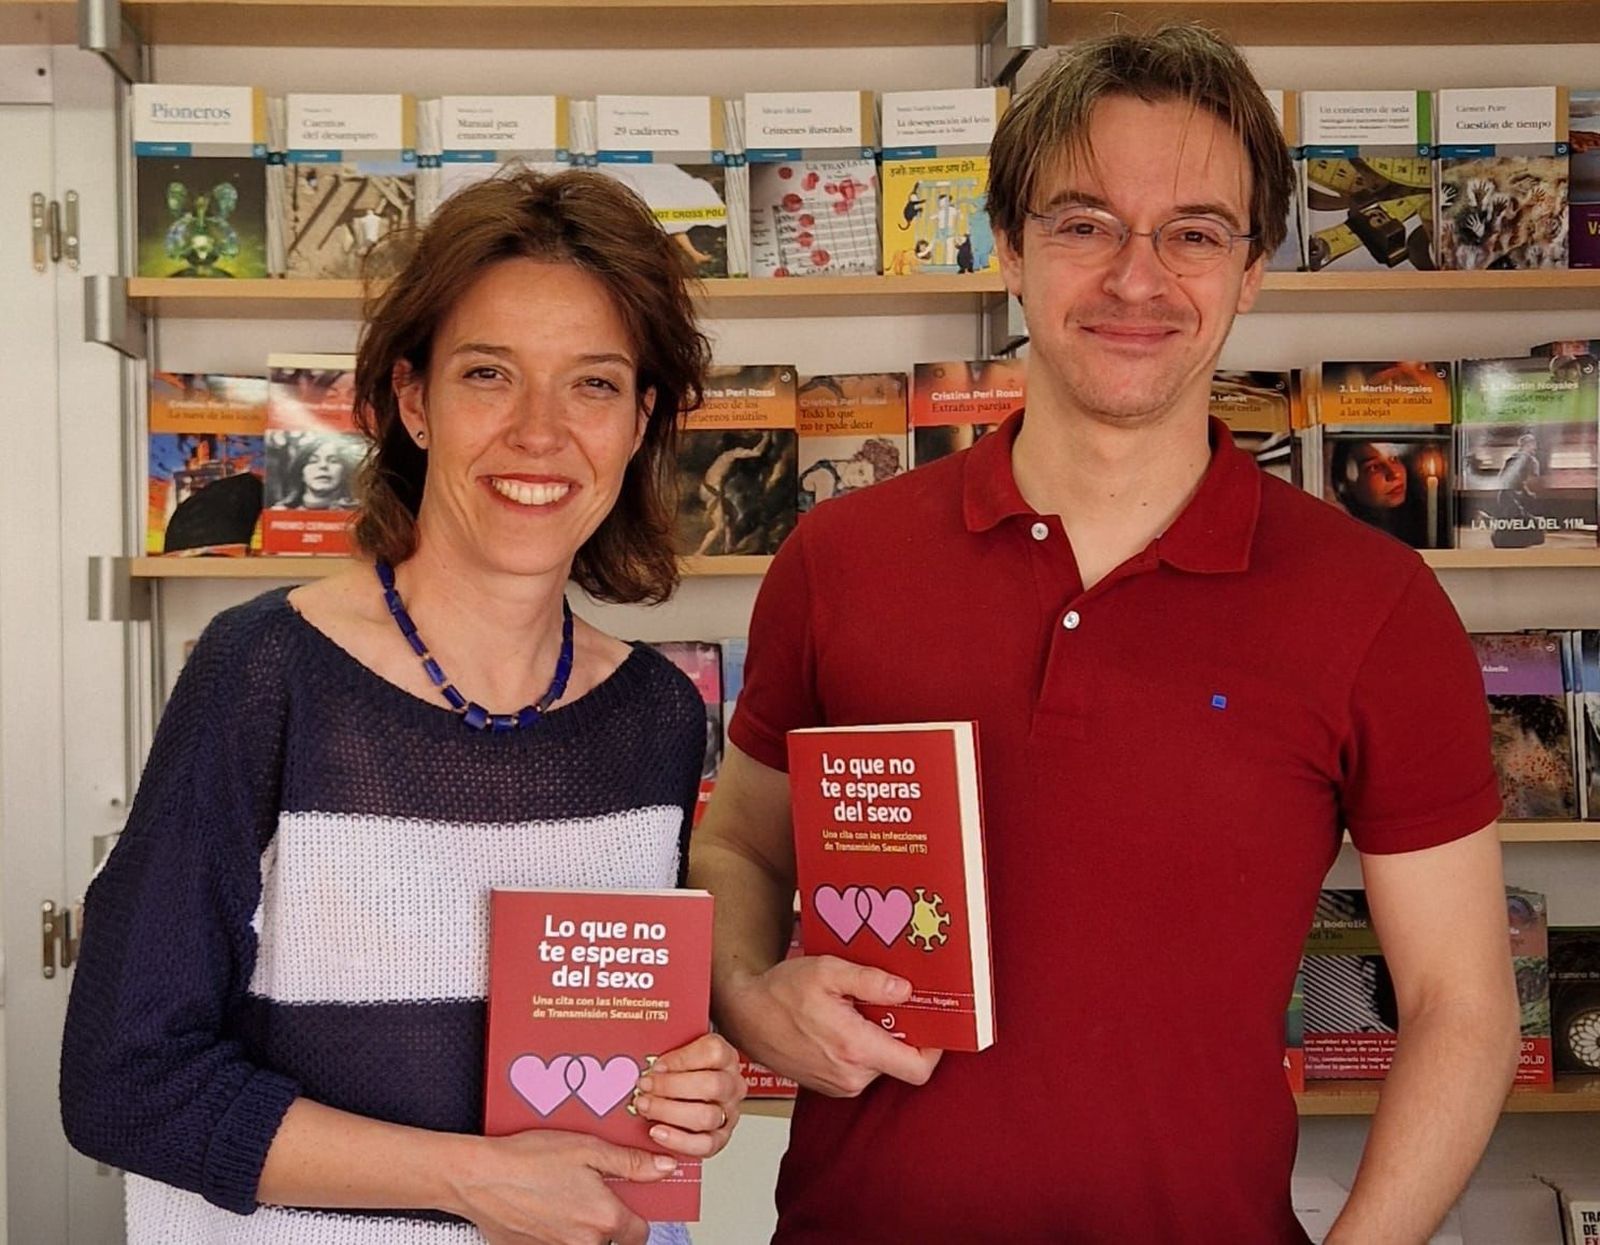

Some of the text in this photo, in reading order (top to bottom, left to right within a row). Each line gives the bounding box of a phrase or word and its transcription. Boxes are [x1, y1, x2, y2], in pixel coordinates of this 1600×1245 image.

[152, 102, 231, 119] Pioneros
[458, 119, 518, 130] Manual para
[808, 125, 853, 135] ilustrados
[1456, 119, 1552, 130] Cuestión de tiempo
[613, 126, 627, 136] 29
[673, 209, 704, 219] CROSS
[725, 387, 776, 397] Peri Rossi
[1395, 384, 1433, 394] Nogales
[1537, 381, 1579, 391] Nogales
[931, 386, 1023, 401] Cristina Peri Rossi
[731, 399, 742, 410] de
[1341, 395, 1352, 405] La
[932, 401, 1012, 413] Extrañas parejas
[1340, 407, 1391, 418] a las abejas
[801, 407, 855, 424] Todo lo que
[800, 422, 813, 431] no
[815, 421, 824, 430] te
[850, 419, 874, 430] decir
[1471, 517, 1585, 531] LA NOVELA DEL 11M
[822, 753, 915, 779] Lo que no
[820, 778, 921, 803] te esperas
[833, 800, 912, 822] del sexo
[822, 829, 838, 839] Una
[839, 831, 853, 840] cita
[854, 832, 869, 840] con
[869, 831, 881, 840] las
[824, 841, 834, 851] de
[835, 842, 881, 852] Transmisión
[881, 843, 908, 853] Sexual
[545, 914, 666, 943] Lo que no
[538, 940, 669, 967] te esperas
[552, 965, 654, 989] del sexo
[533, 995, 670, 1008] Una cita con las Infecciones
[533, 1008, 669, 1022] de Transmisión Sexual (ITS)
[760, 1077, 773, 1087] DE
[1583, 1223, 1599, 1236] DE
